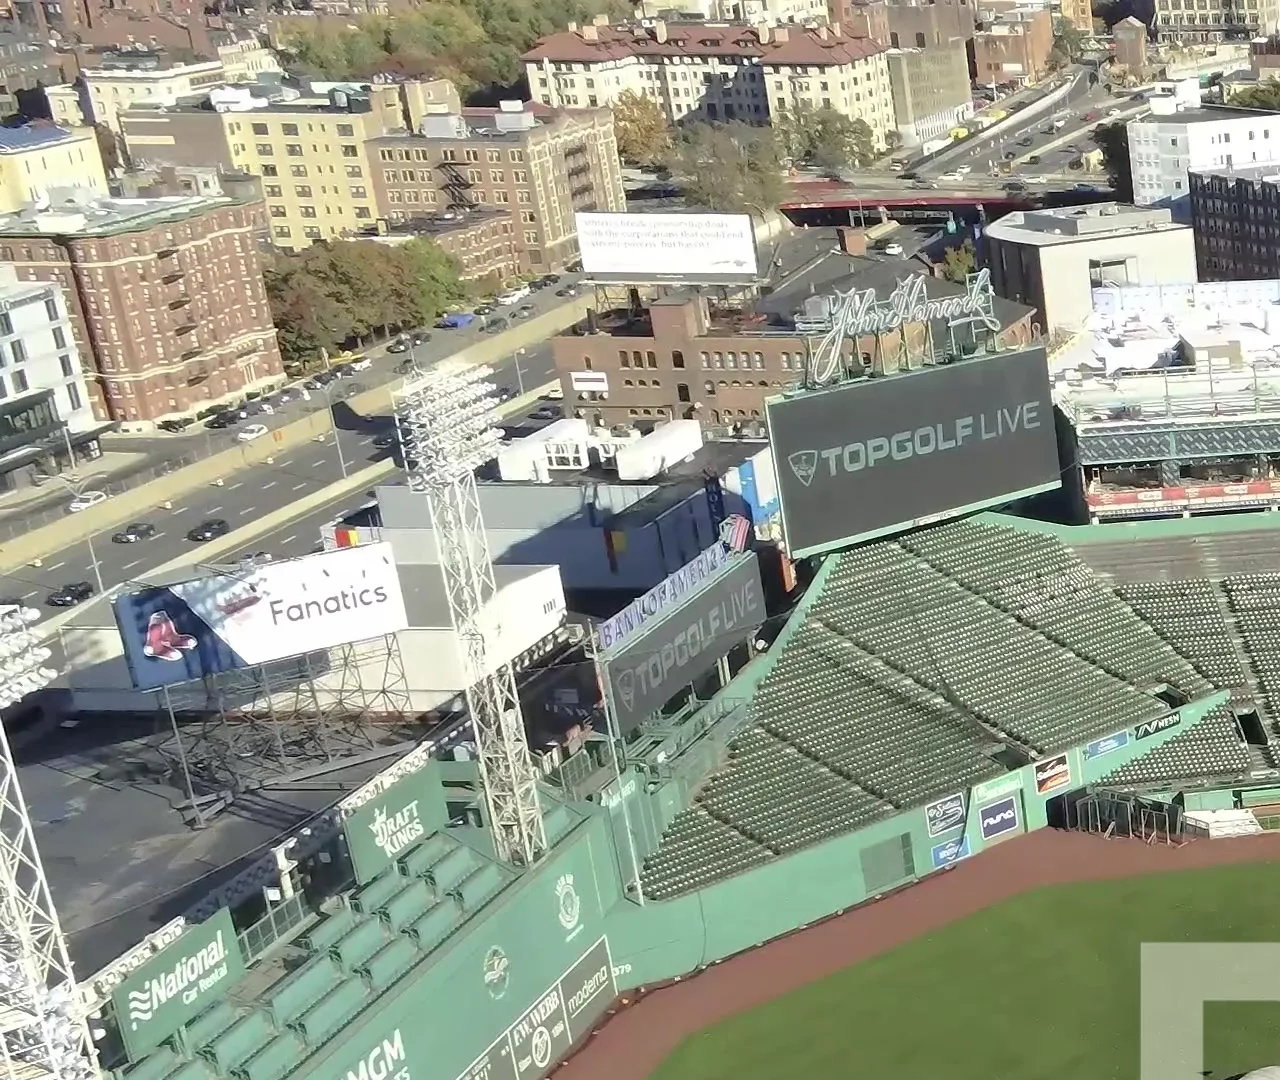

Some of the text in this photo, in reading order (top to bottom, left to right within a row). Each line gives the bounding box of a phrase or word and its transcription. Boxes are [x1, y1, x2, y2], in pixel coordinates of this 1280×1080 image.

[814, 268, 1000, 382] John Hancock
[821, 401, 1041, 477] TOPGOLF LIVE
[269, 585, 388, 625] Fanatics
[602, 541, 729, 648] BANK OF AMERICA
[634, 578, 758, 695] TOPGOLF LIVE
[1157, 713, 1180, 728] NESN
[375, 800, 418, 847] DRAFT
[384, 818, 424, 858] KINGS
[151, 929, 225, 1012] National
[182, 962, 228, 1005] Car Rental
[612, 963, 632, 978] 379
[531, 990, 560, 1028] WEBB
